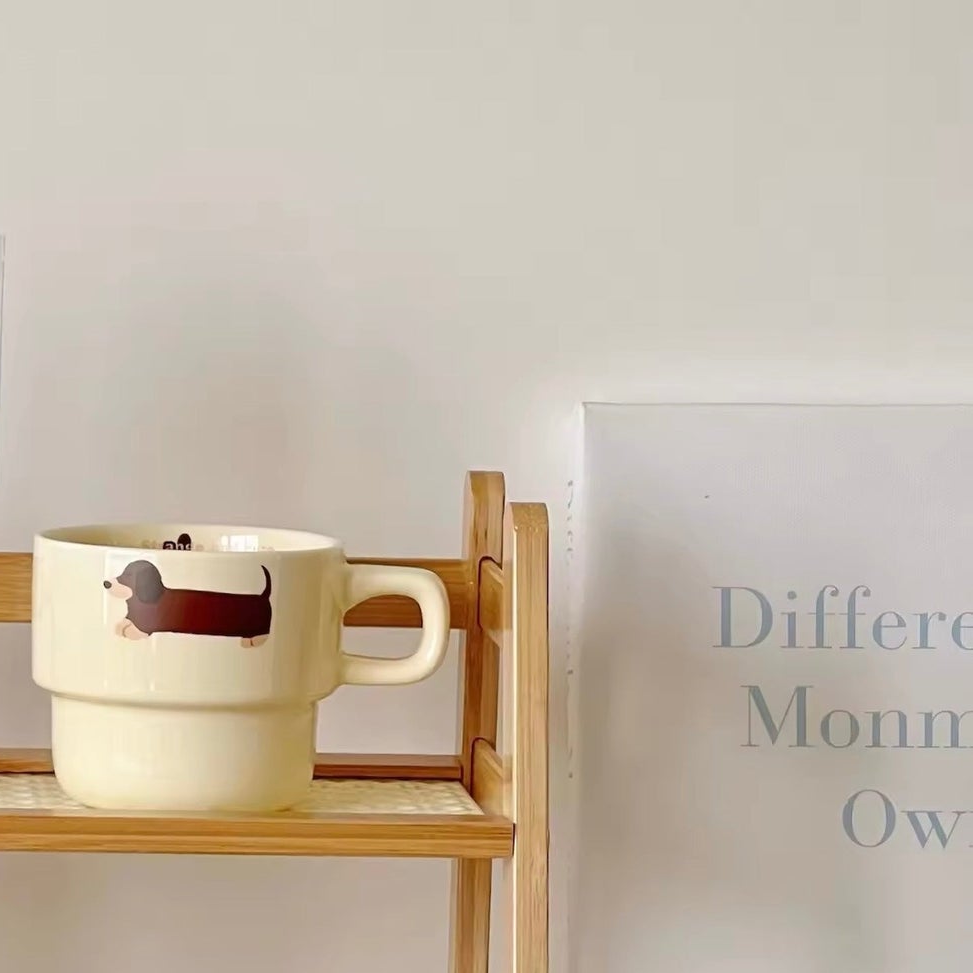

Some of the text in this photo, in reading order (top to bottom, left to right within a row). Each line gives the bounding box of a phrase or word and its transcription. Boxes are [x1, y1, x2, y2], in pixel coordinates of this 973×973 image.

[711, 584, 973, 650] Differe
[739, 685, 973, 749] Monm
[841, 789, 973, 849] Ow
